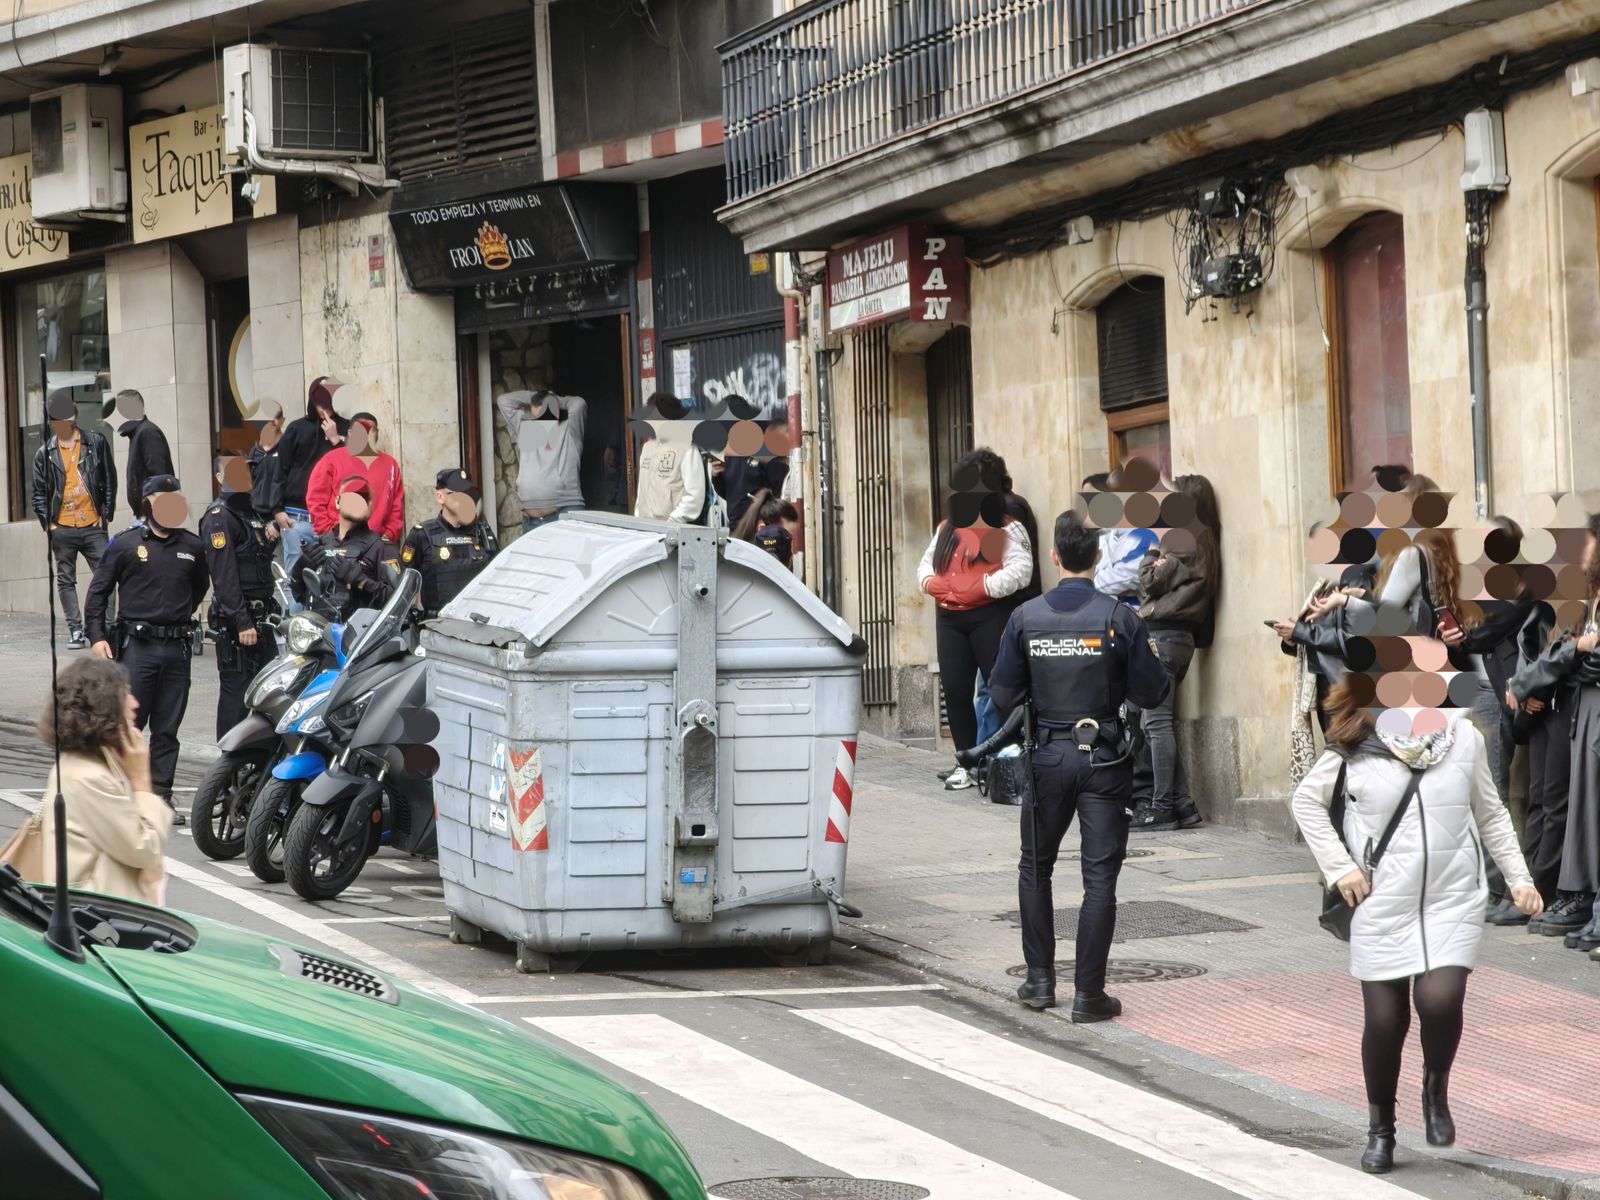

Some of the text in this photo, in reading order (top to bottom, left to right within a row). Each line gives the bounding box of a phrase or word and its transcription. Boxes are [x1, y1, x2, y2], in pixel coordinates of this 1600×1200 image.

[194, 119, 208, 136] Bar
[410, 193, 542, 225] TODO EMPIEZA Y TERMINA EN
[842, 238, 894, 278] MAJELU
[922, 237, 952, 320] PAN
[1029, 638, 1086, 648] POLICIA
[1030, 647, 1102, 657] NACIONAL
